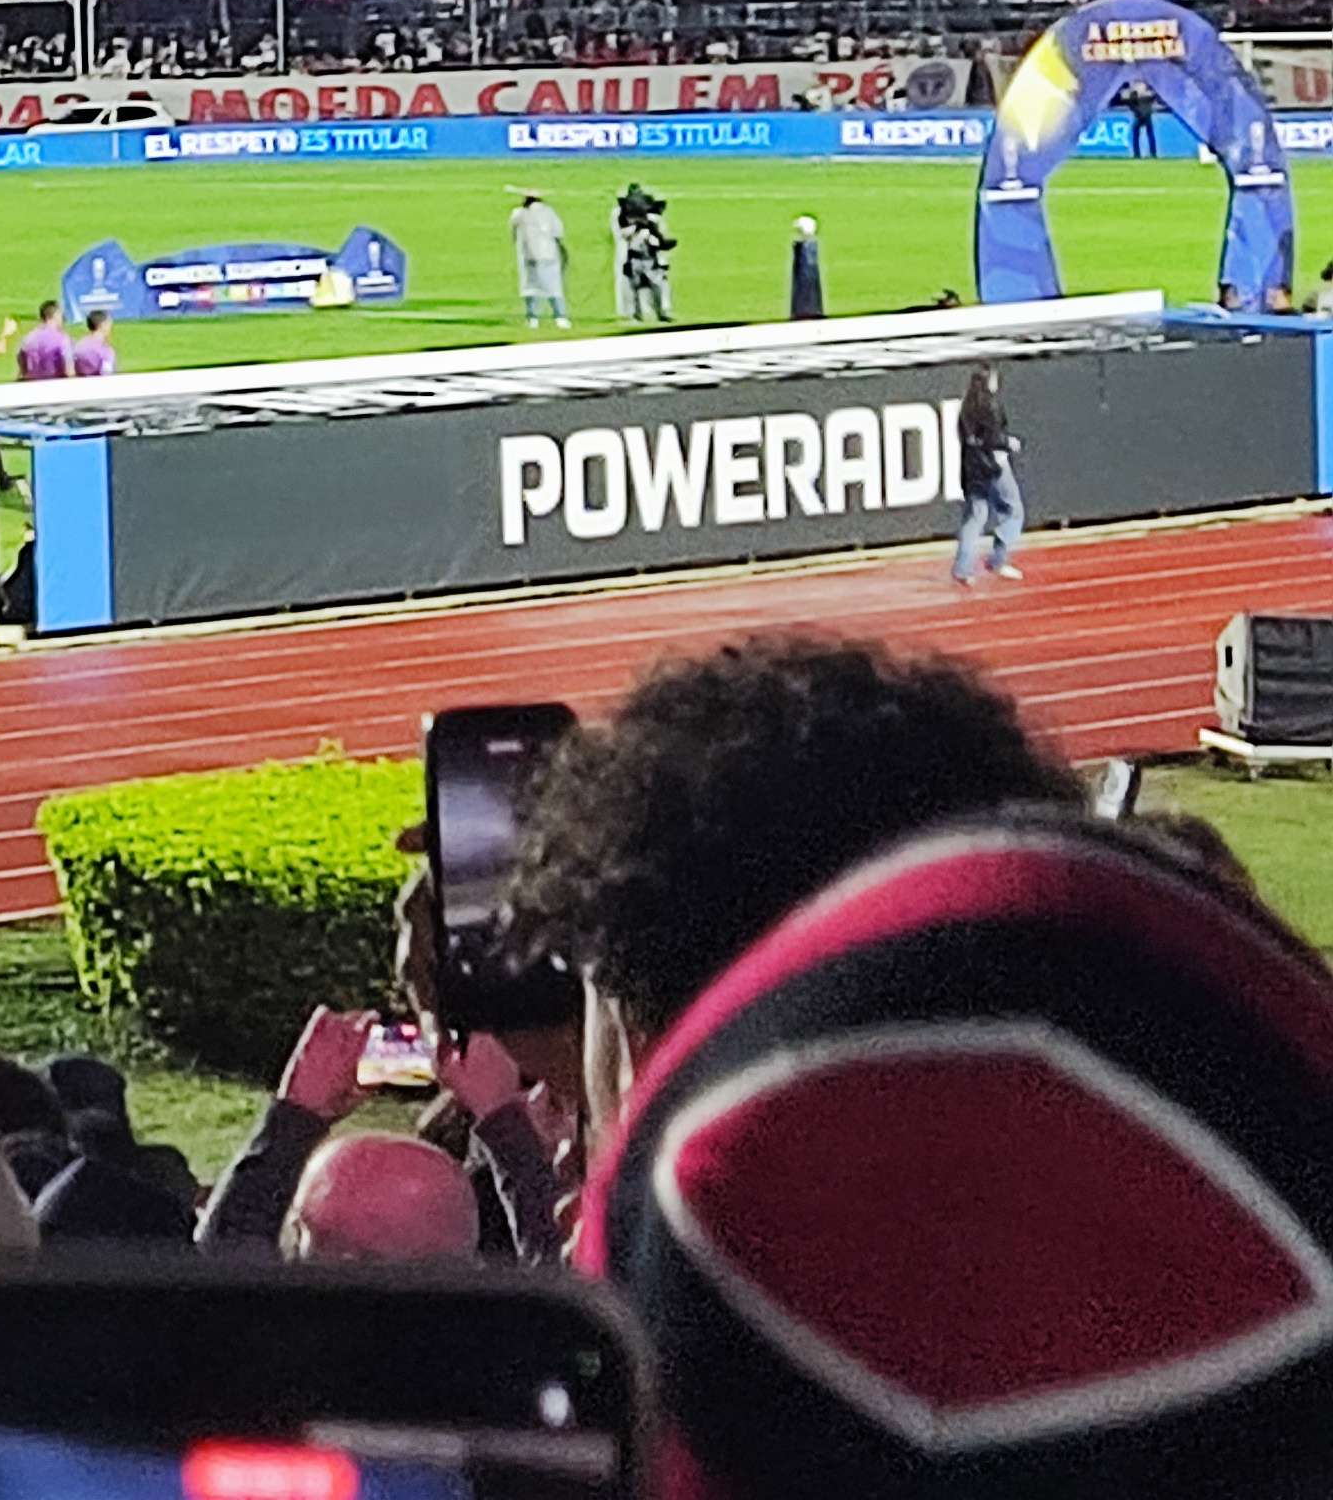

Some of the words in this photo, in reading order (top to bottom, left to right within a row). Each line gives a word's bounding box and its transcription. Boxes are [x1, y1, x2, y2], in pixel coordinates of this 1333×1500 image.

[189, 83, 449, 123] MOEDA
[478, 76, 650, 116] CAIU
[678, 73, 780, 111] EM
[145, 133, 179, 158] EL
[180, 129, 298, 156] RESPETO
[301, 128, 328, 153] ES
[333, 126, 428, 151] TITULAR
[509, 124, 536, 148] EL
[537, 121, 638, 148] RESPETO
[640, 122, 670, 146] ES
[673, 121, 771, 146] TITULAR
[842, 121, 869, 146] EL
[873, 118, 983, 146] RESPETO
